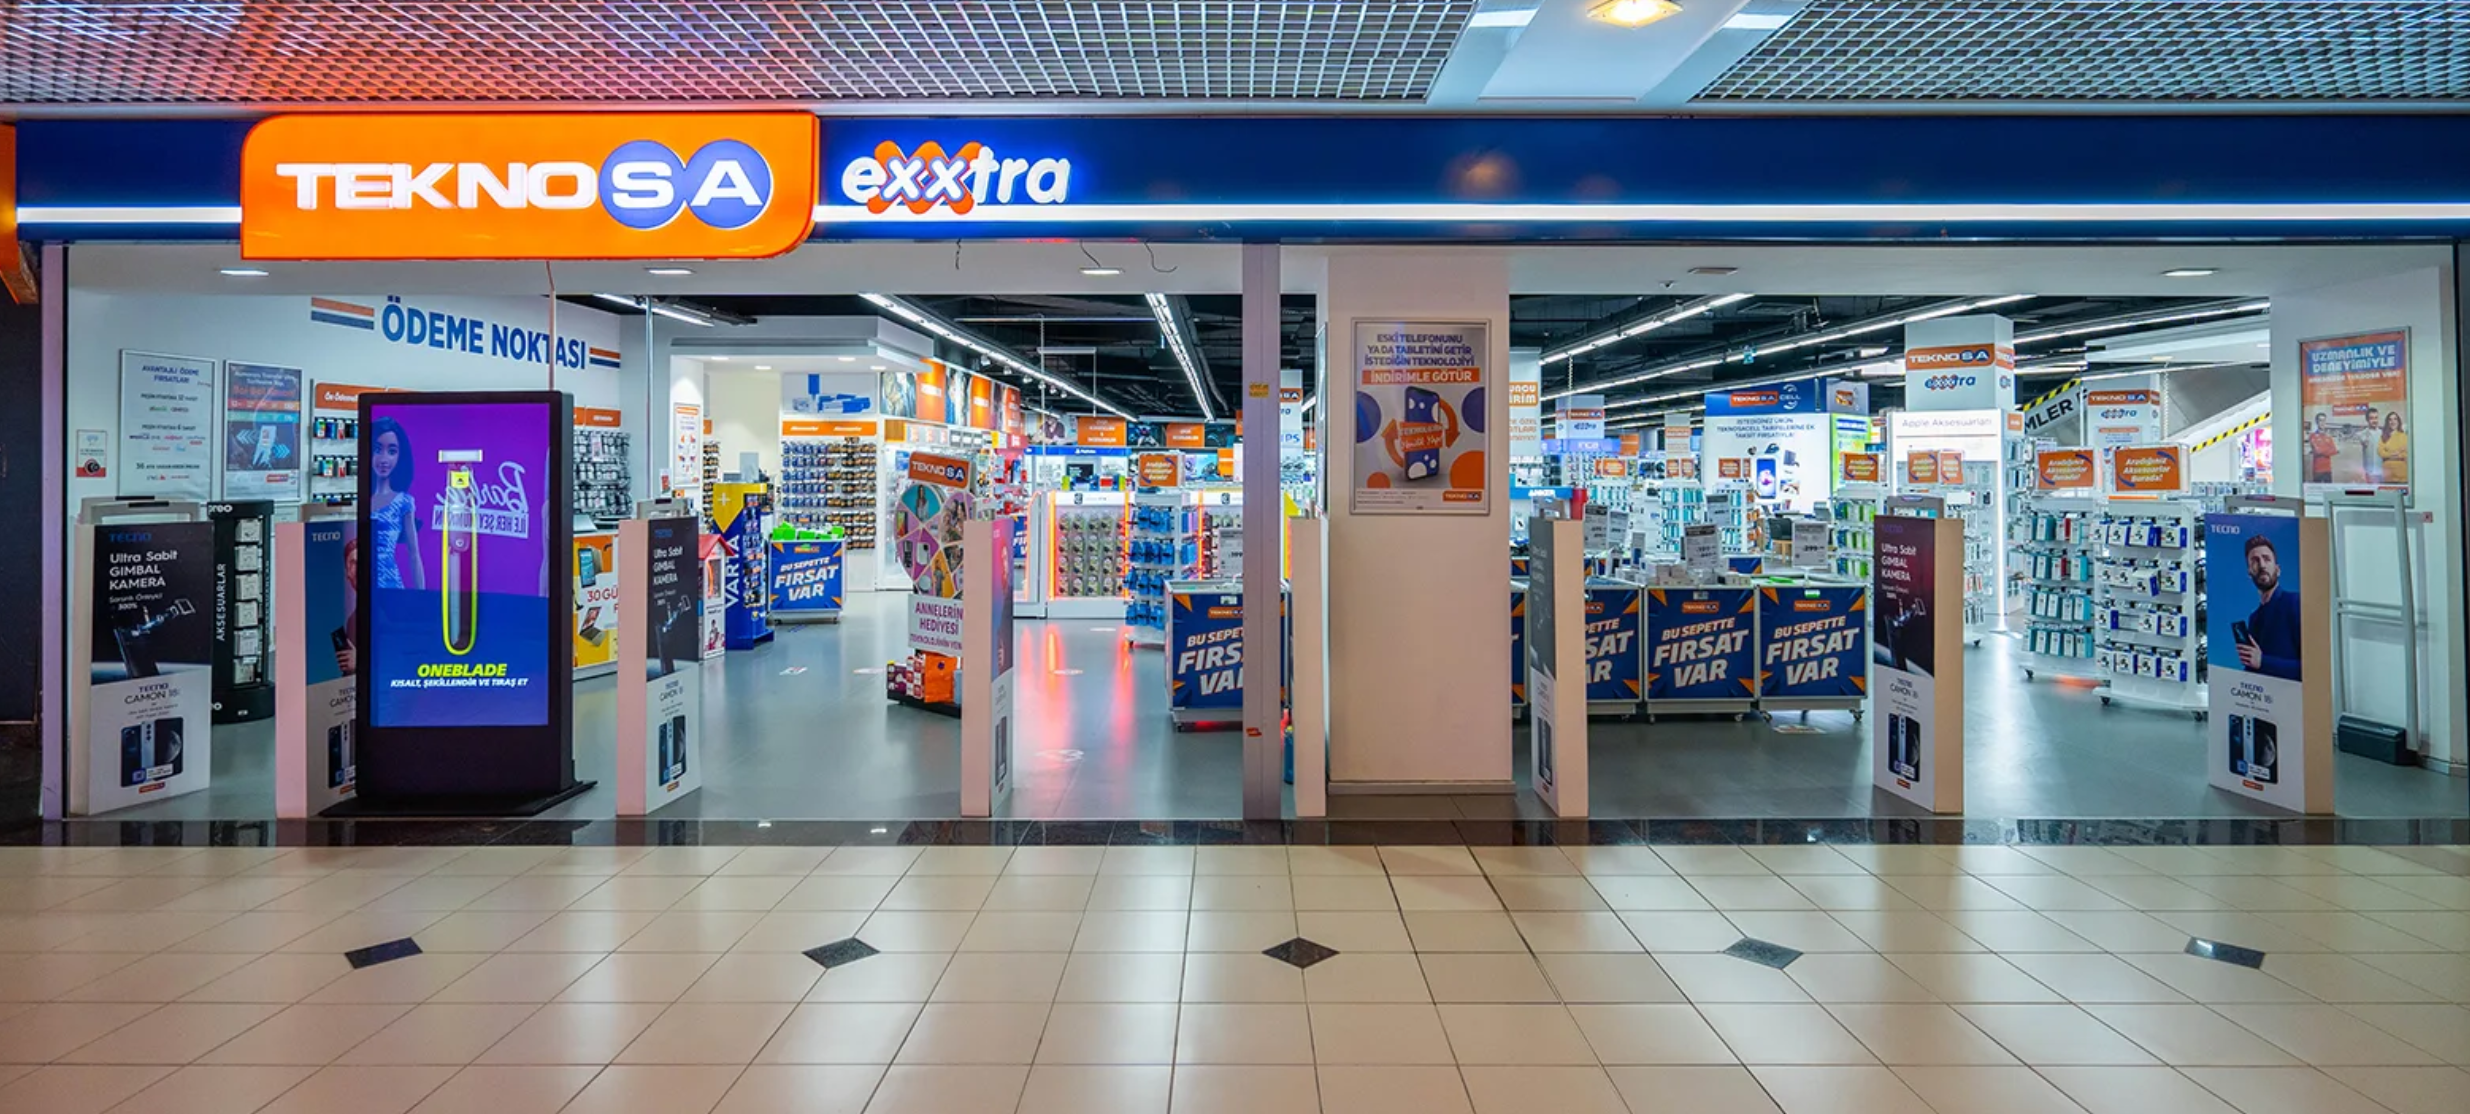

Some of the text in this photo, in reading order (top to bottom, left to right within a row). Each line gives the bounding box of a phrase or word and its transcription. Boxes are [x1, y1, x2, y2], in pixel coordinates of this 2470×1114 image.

[841, 145, 1072, 204] exxtra
[276, 162, 762, 209] TEKNOSA
[382, 296, 586, 370] ÖDEME NOKTASI
[1377, 331, 1462, 343] ESKİ TELEFONUNU
[1368, 343, 1472, 355] YA DA TABLETİNİ GETİR
[2312, 345, 2395, 361] UZMANLIK VE
[1412, 354, 1475, 366] TEKNOLOJİYİ
[1909, 351, 1989, 364] TEKNOSA
[2312, 355, 2395, 373] DENEYİMİYLE
[1370, 367, 1472, 383] İNDİRİMLE GÖTÜR
[1925, 375, 1976, 390] exxtra
[1902, 417, 1992, 428] Apple Aksesuarları
[2024, 398, 2074, 433] MLER
[911, 460, 966, 483] TEKNOSA
[312, 531, 341, 542] TECNO
[2210, 523, 2241, 535] TECNO
[109, 533, 152, 543] TECNO
[110, 549, 178, 564] Ultra Sabit
[1881, 543, 1917, 556] Ultra Sabit
[109, 564, 161, 577] GIMBAL
[725, 534, 740, 609] VARTA
[774, 564, 839, 589] FIRSAT
[1881, 568, 1912, 582] KAMERA
[109, 576, 166, 591] KAMERA
[653, 572, 679, 586] KAMERA
[587, 585, 618, 603] 30 GÜ
[788, 583, 825, 602] VAR
[216, 563, 227, 642] AKSESUARLAR
[915, 601, 964, 620] ANNELERİN
[918, 616, 960, 636] HEDİYESİ
[1586, 617, 1620, 632] PETTE
[1661, 616, 1735, 642] BU SEPETTE
[1773, 615, 1847, 640] BU SEPETTE
[1187, 634, 1206, 648] BU
[1586, 630, 1634, 660] SAT
[1653, 629, 1749, 668] FIRSAT
[1765, 627, 1860, 665] FIRSAT
[1178, 642, 1243, 675] FIRS
[417, 663, 508, 678] ONEBLADE
[1586, 659, 1613, 684] AR
[1674, 658, 1728, 688] VAR
[1786, 657, 1839, 687] VAR
[139, 682, 169, 692] TECNO
[390, 677, 529, 689] KISALT, ŞEKİLLENDİR VE TIRAŞ ET
[1200, 669, 1243, 696] VA
[2239, 682, 2264, 694] TECNO
[124, 690, 167, 705] CAMON
[2230, 686, 2262, 702] CAMON
